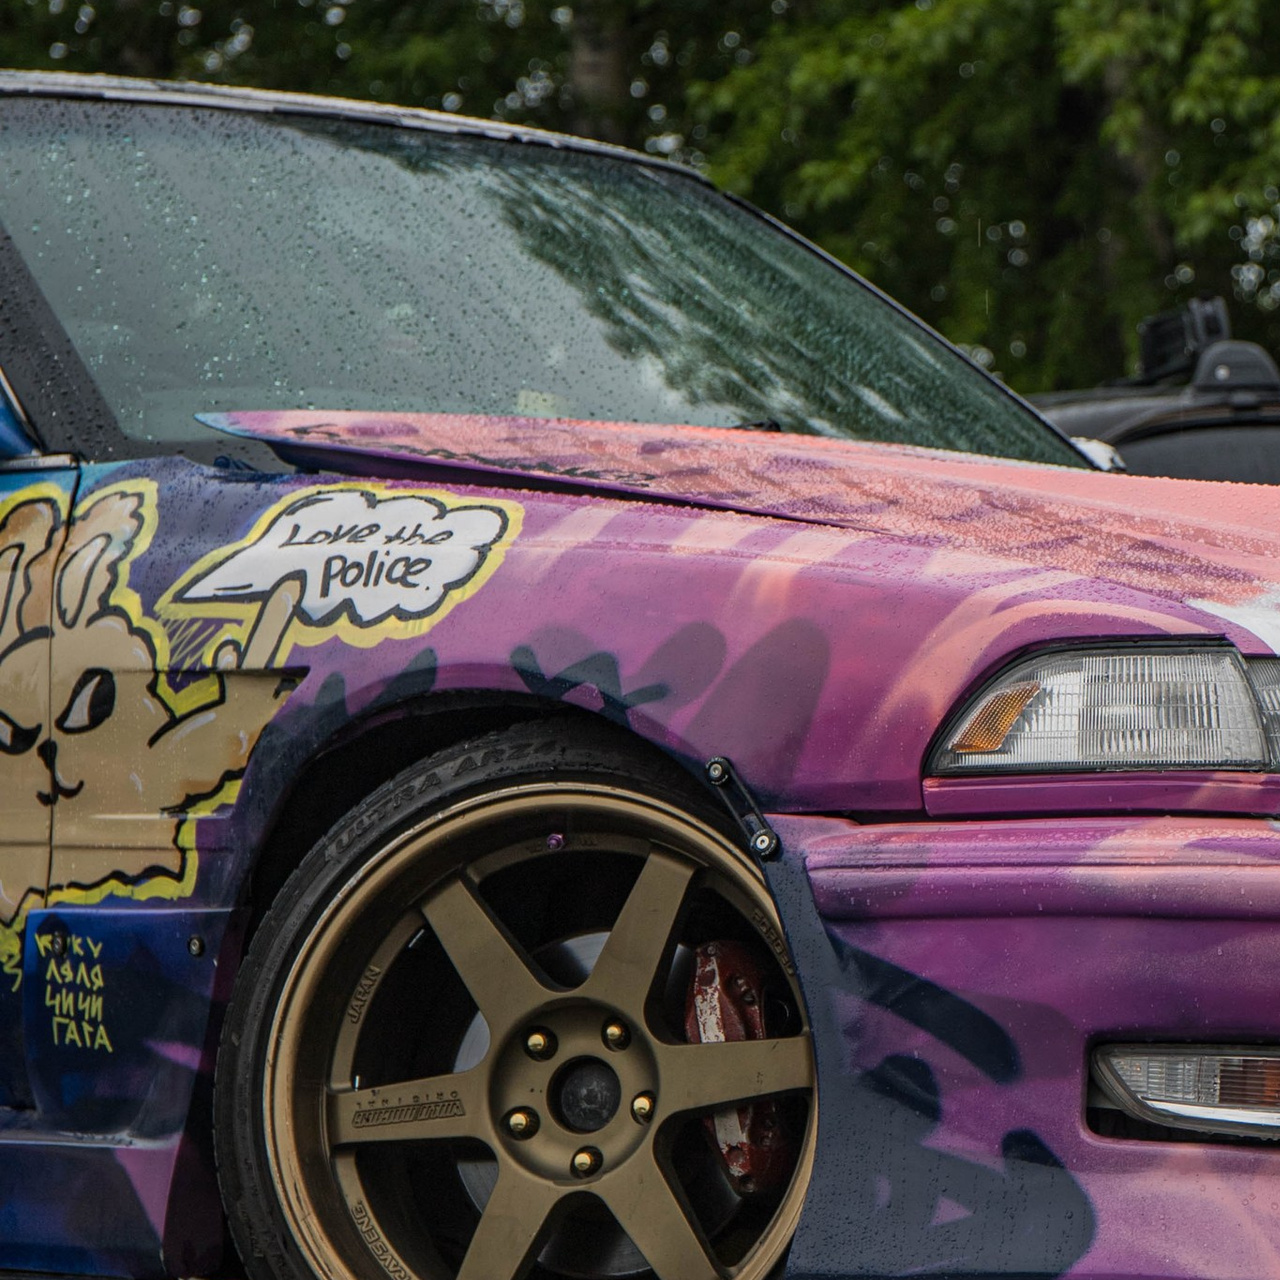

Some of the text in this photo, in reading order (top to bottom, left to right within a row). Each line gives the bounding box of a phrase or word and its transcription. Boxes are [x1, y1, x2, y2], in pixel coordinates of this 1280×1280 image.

[279, 523, 454, 548] Love the
[34, 932, 103, 959] ККУ
[347, 965, 382, 1025] JAPAN
